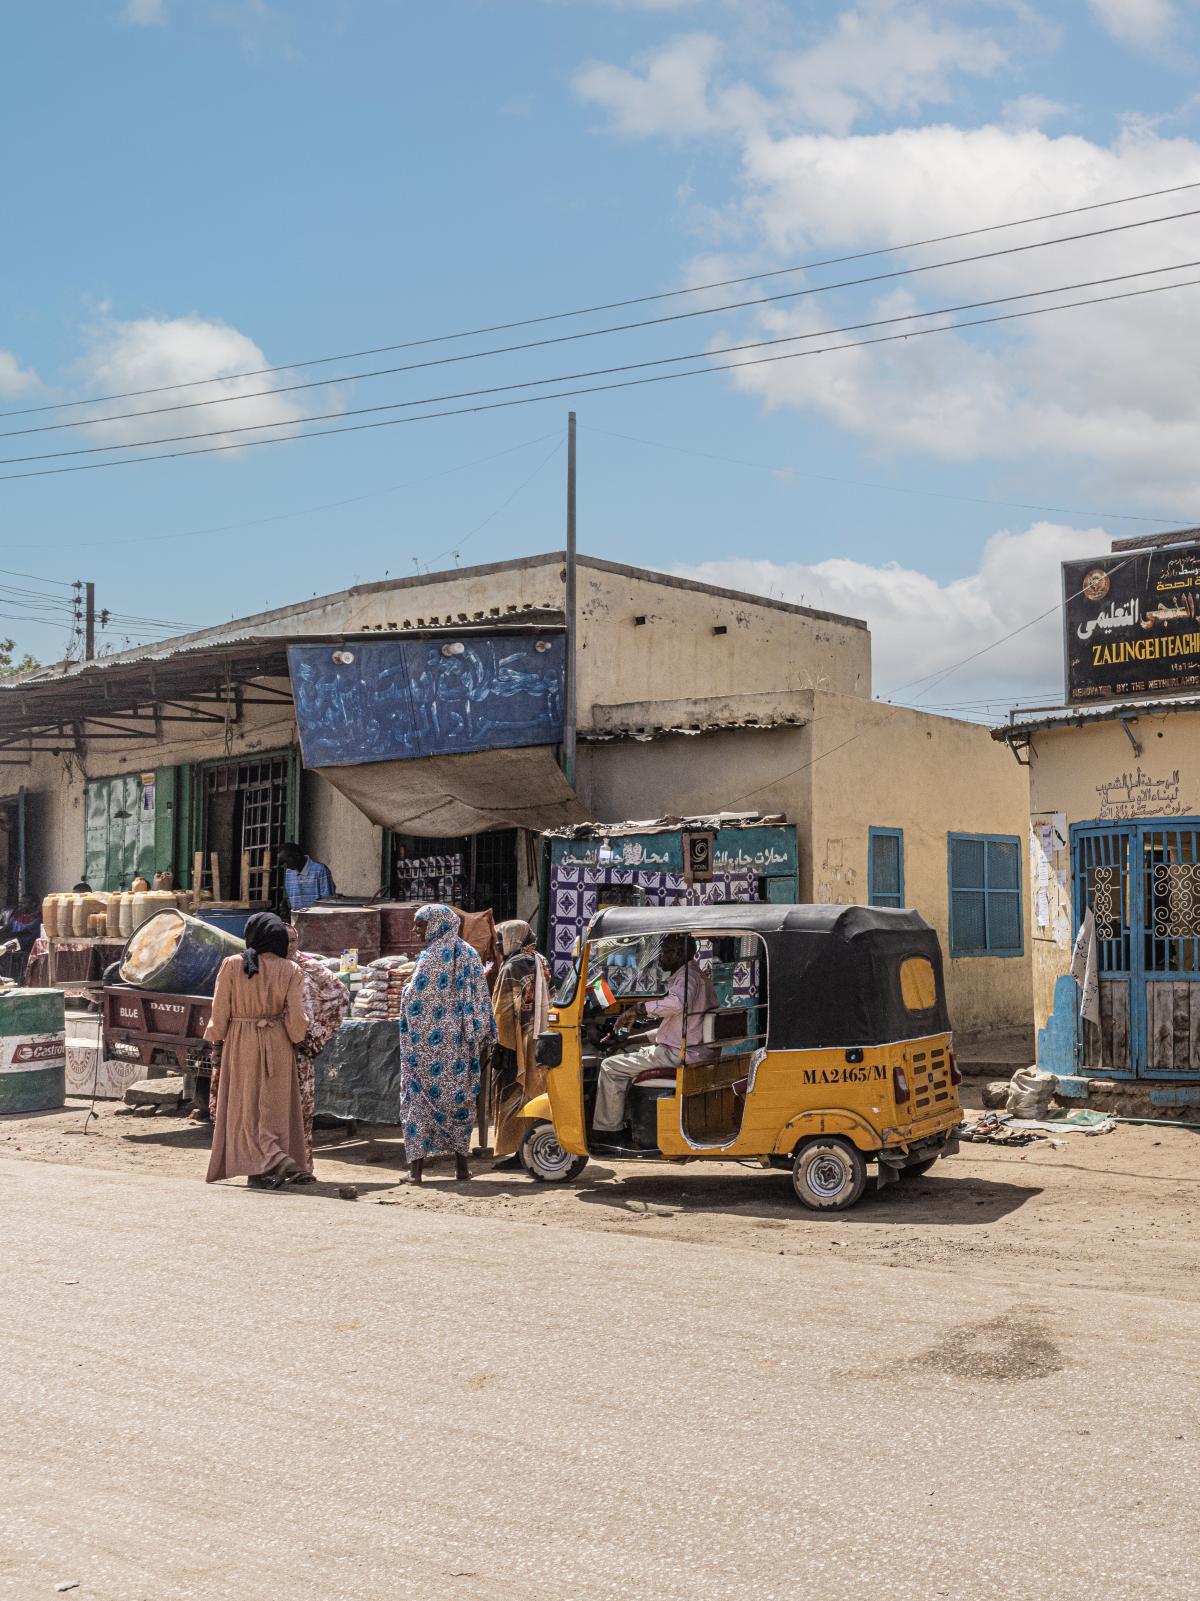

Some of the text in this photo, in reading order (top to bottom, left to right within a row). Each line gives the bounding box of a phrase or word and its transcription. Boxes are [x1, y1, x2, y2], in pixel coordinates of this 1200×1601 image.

[1156, 576, 1193, 591] الصحة
[1092, 638, 1160, 666] ZALINGEI
[622, 842, 669, 865] محل
[712, 850, 728, 866] الش
[754, 847, 788, 866] محلات
[802, 1064, 889, 1085] MA2465/M
